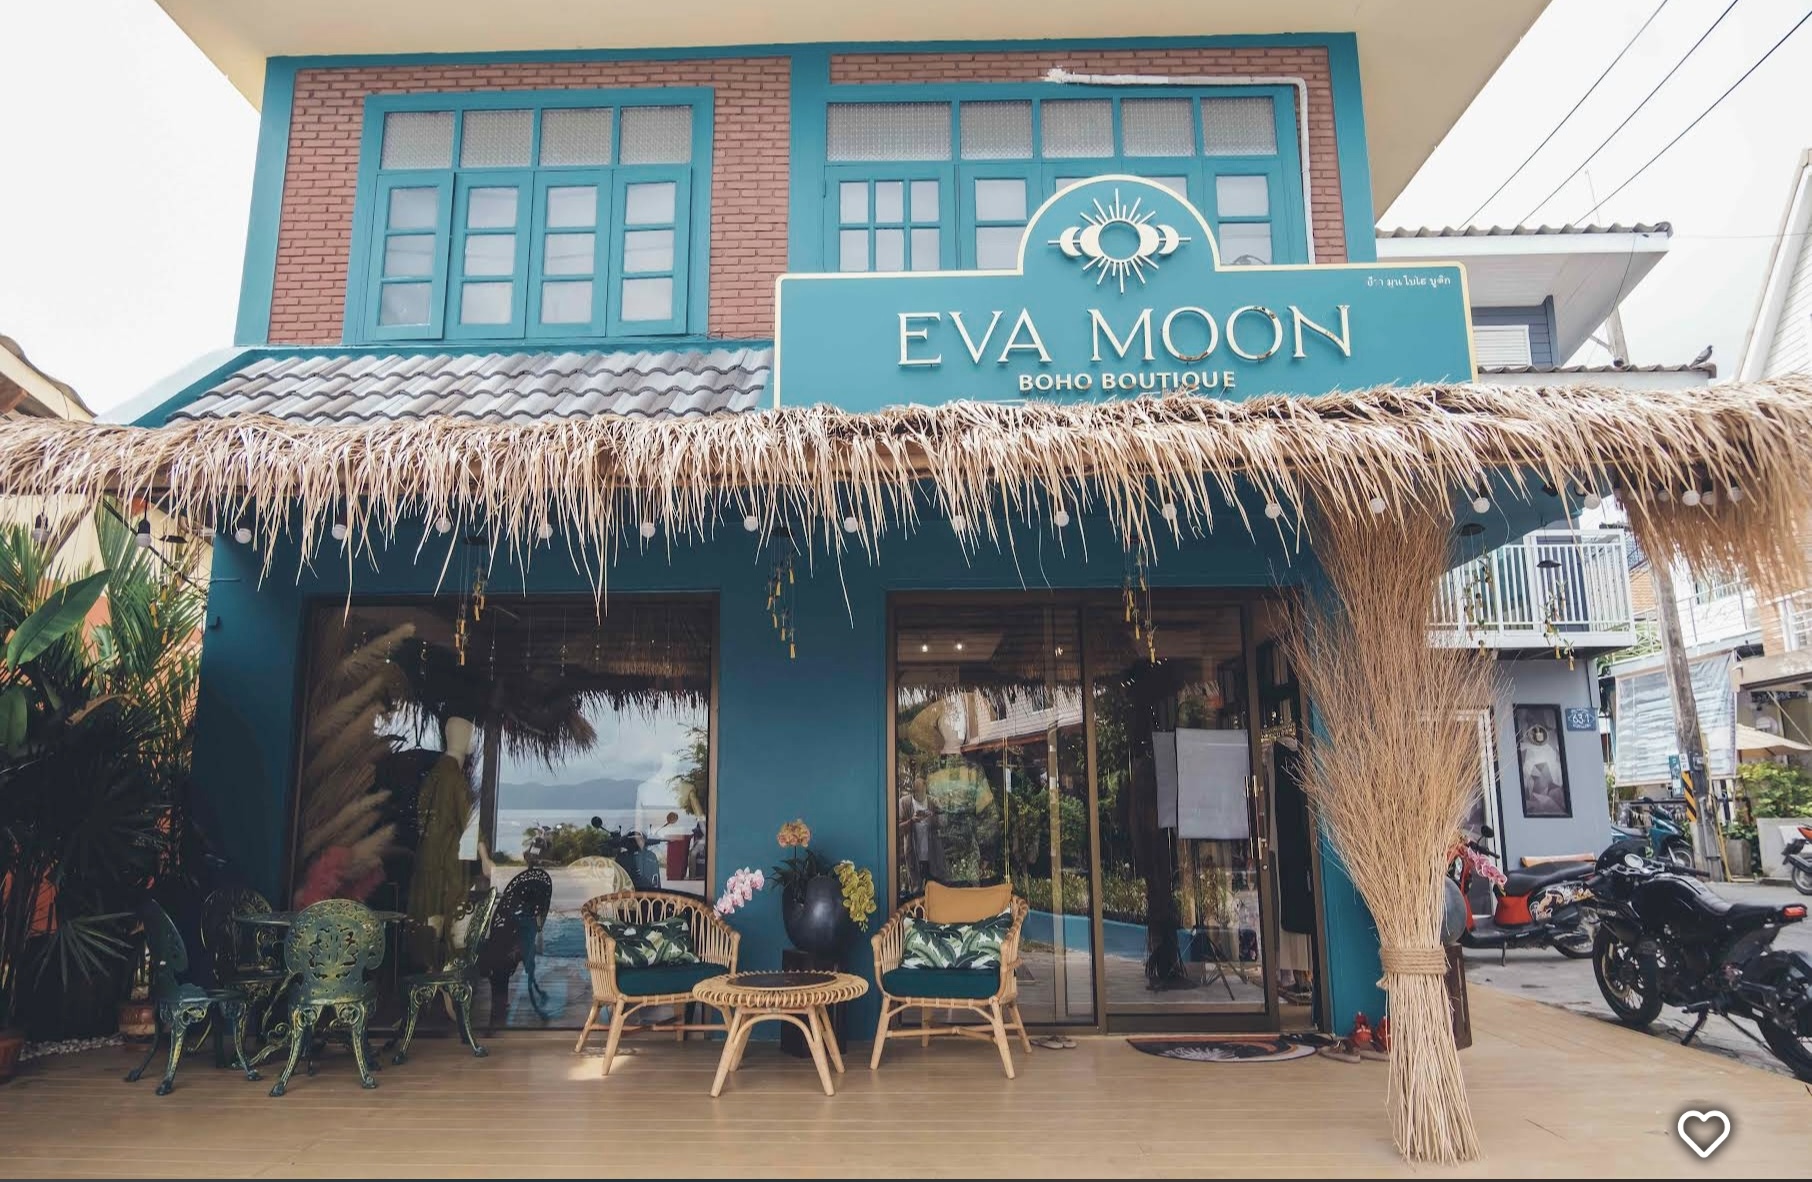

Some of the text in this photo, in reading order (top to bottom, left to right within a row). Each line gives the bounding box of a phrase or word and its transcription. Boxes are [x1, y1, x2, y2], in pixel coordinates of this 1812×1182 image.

[897, 304, 1352, 367] EVA MOON
[1019, 371, 1236, 391] BOHO BOUTIQUE
